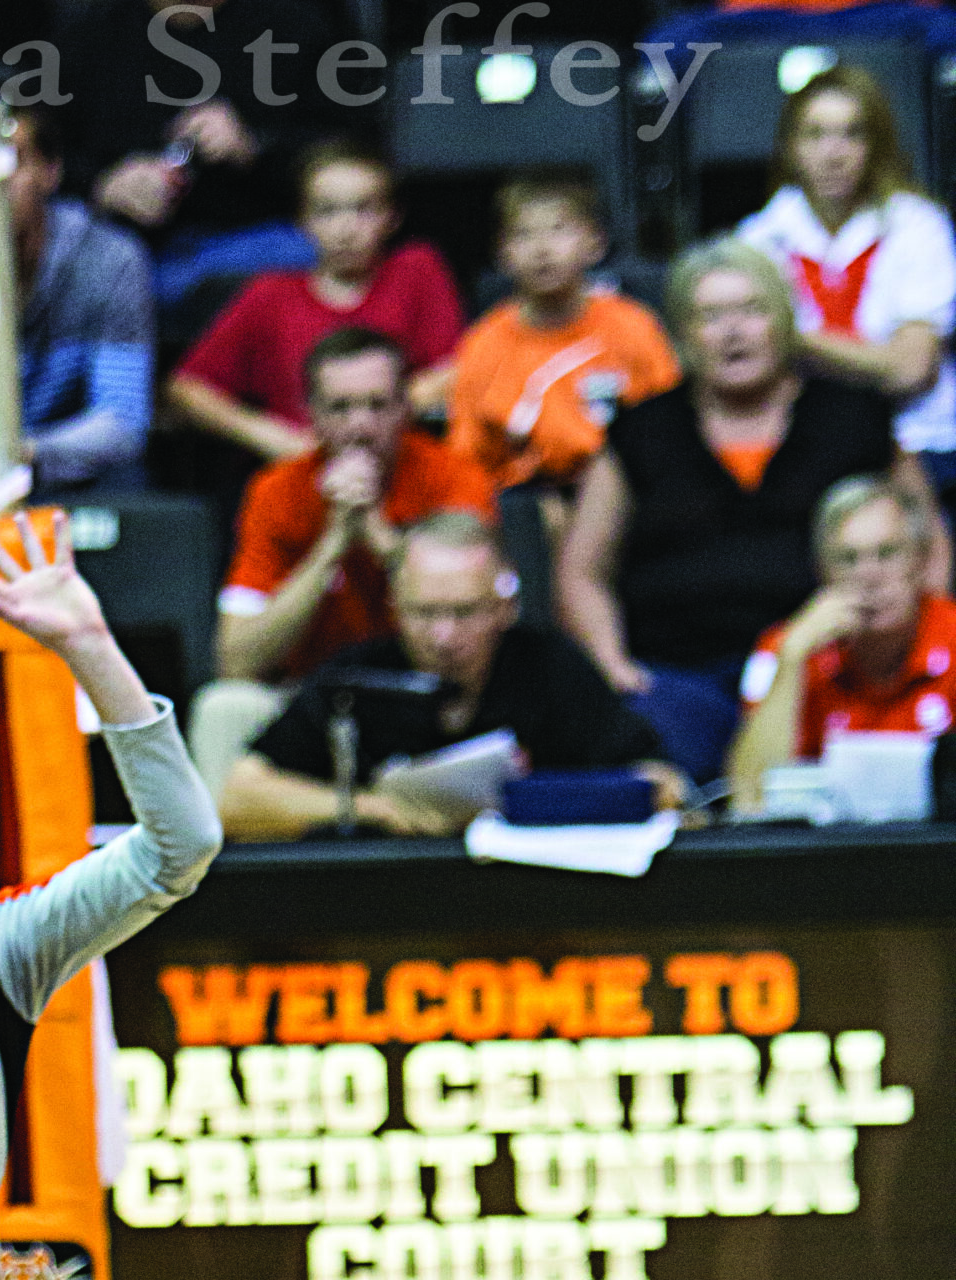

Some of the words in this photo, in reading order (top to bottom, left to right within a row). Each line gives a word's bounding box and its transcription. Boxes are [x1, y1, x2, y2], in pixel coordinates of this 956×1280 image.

[158, 953, 653, 1046] WELCOME
[663, 950, 800, 1036] TO
[116, 1042, 390, 1140] DAHO
[403, 1030, 914, 1135] CENTRAL
[113, 1130, 497, 1228] CREDIT
[509, 1126, 860, 1218] UNION
